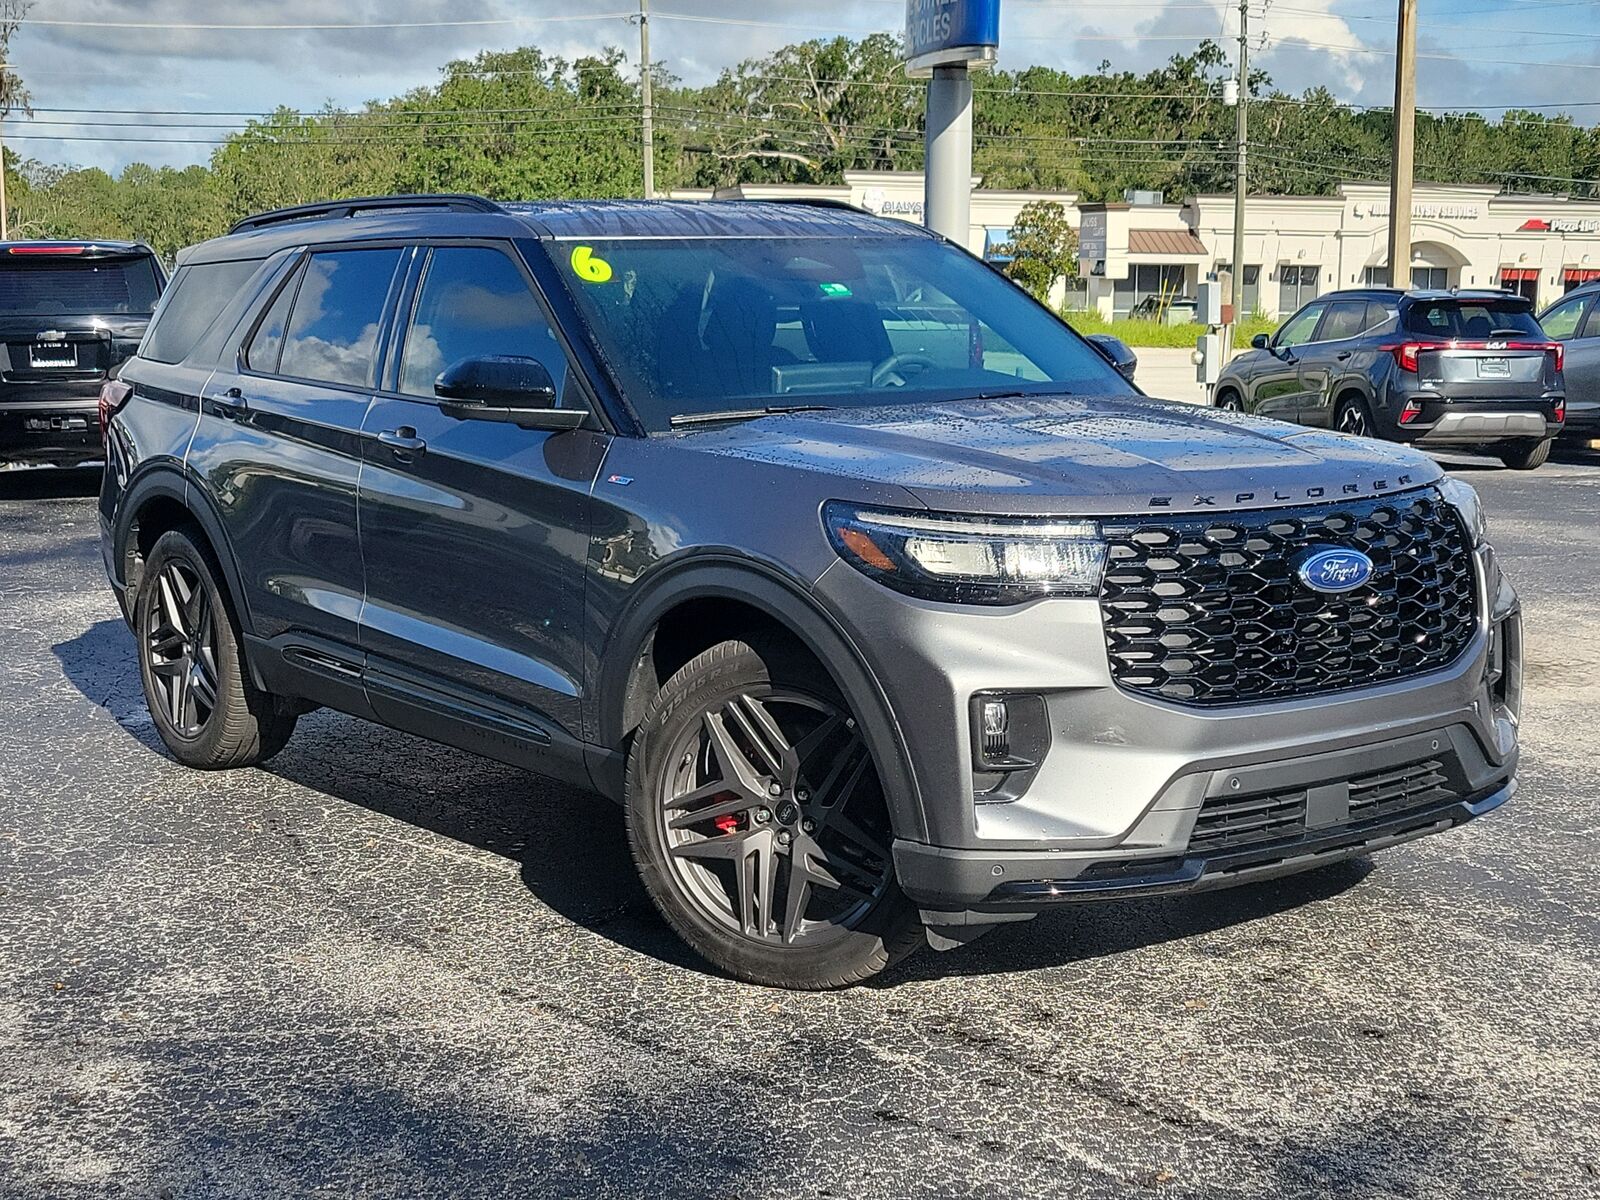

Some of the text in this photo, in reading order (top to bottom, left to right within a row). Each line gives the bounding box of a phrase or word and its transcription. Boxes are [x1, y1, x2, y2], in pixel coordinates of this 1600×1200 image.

[883, 200, 922, 212] DIALYS
[1551, 219, 1599, 232] Pizza Hut
[571, 246, 612, 283] 6
[1149, 474, 1412, 507] EXPLORER
[1321, 558, 1360, 583] Ford
